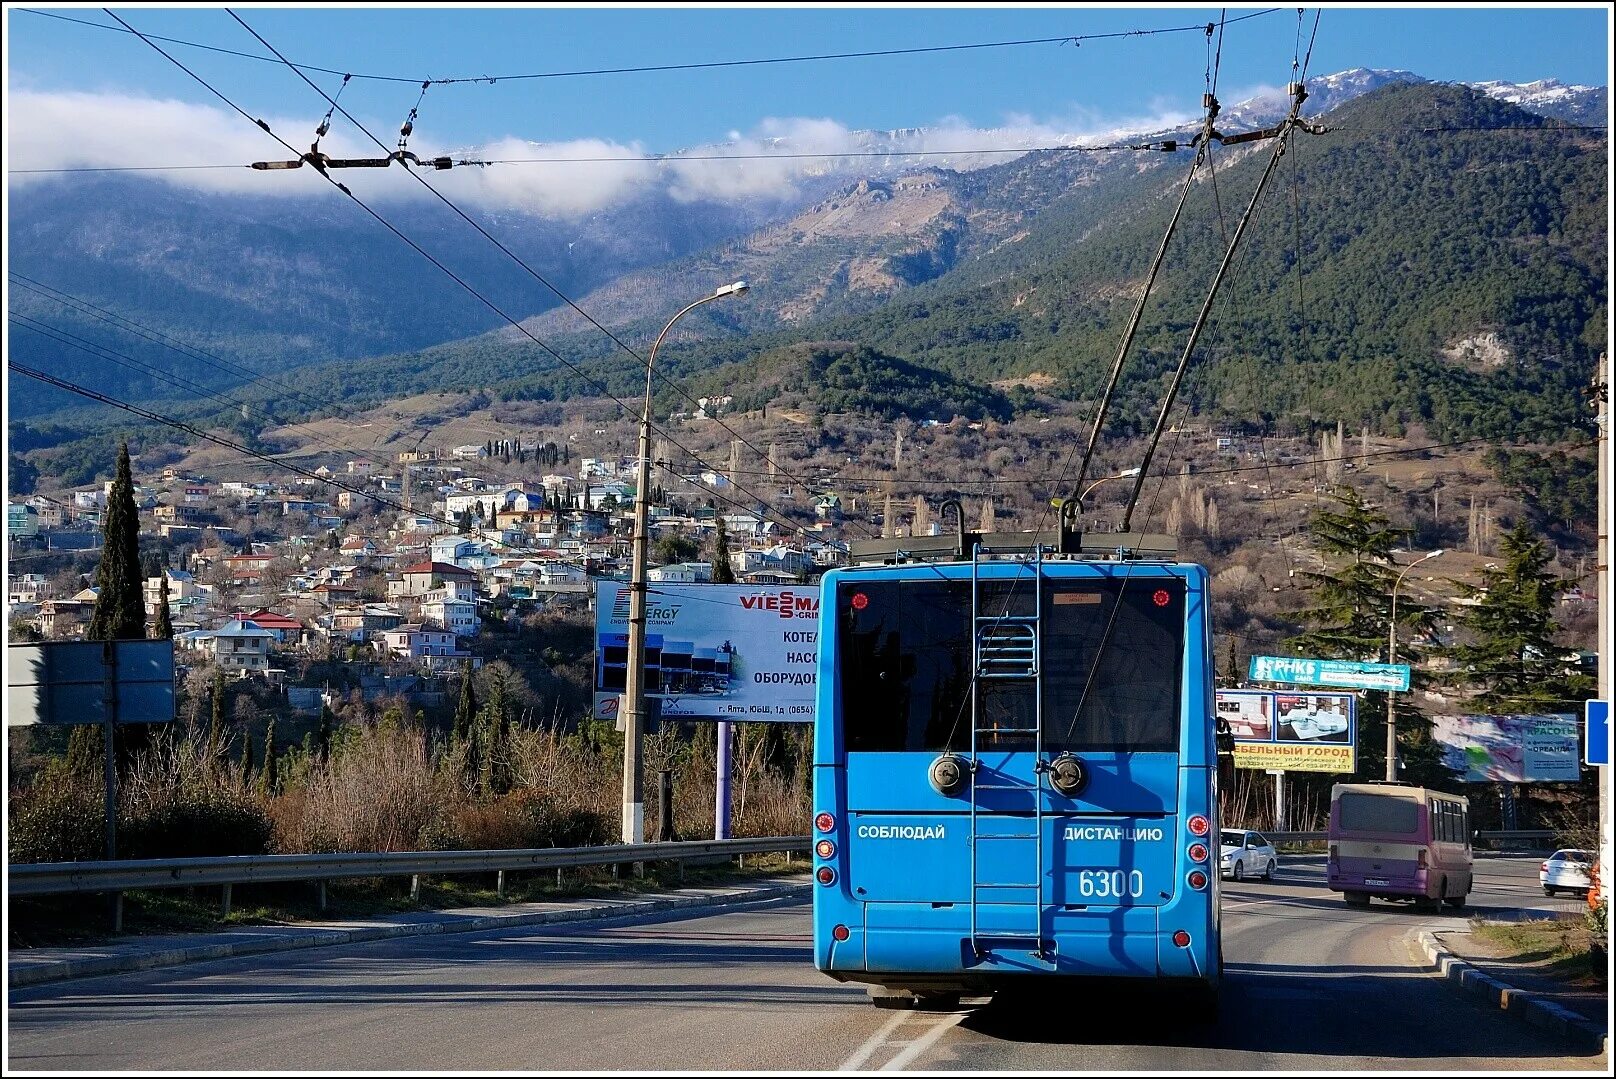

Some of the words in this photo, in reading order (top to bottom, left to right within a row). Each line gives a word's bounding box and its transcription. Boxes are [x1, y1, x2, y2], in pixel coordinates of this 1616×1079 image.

[786, 652, 817, 663] НАСО
[1274, 660, 1316, 675] РНКБ
[754, 672, 817, 686] ОБОРУДОВ
[727, 705, 747, 714] Ялта,
[749, 705, 772, 714] ЮБШ,
[775, 705, 784, 714] 1д
[788, 705, 816, 714] (0654)
[1527, 727, 1576, 735] КРАСОТЫ
[1234, 745, 1303, 756] ЕБЕЛЬНЫЙ
[1307, 747, 1350, 758] ГОРОД
[858, 824, 945, 840] СОБЛЮДАЙ
[1063, 826, 1163, 842] ДИСТАНЦИЮ
[1078, 869, 1143, 898] 6300
